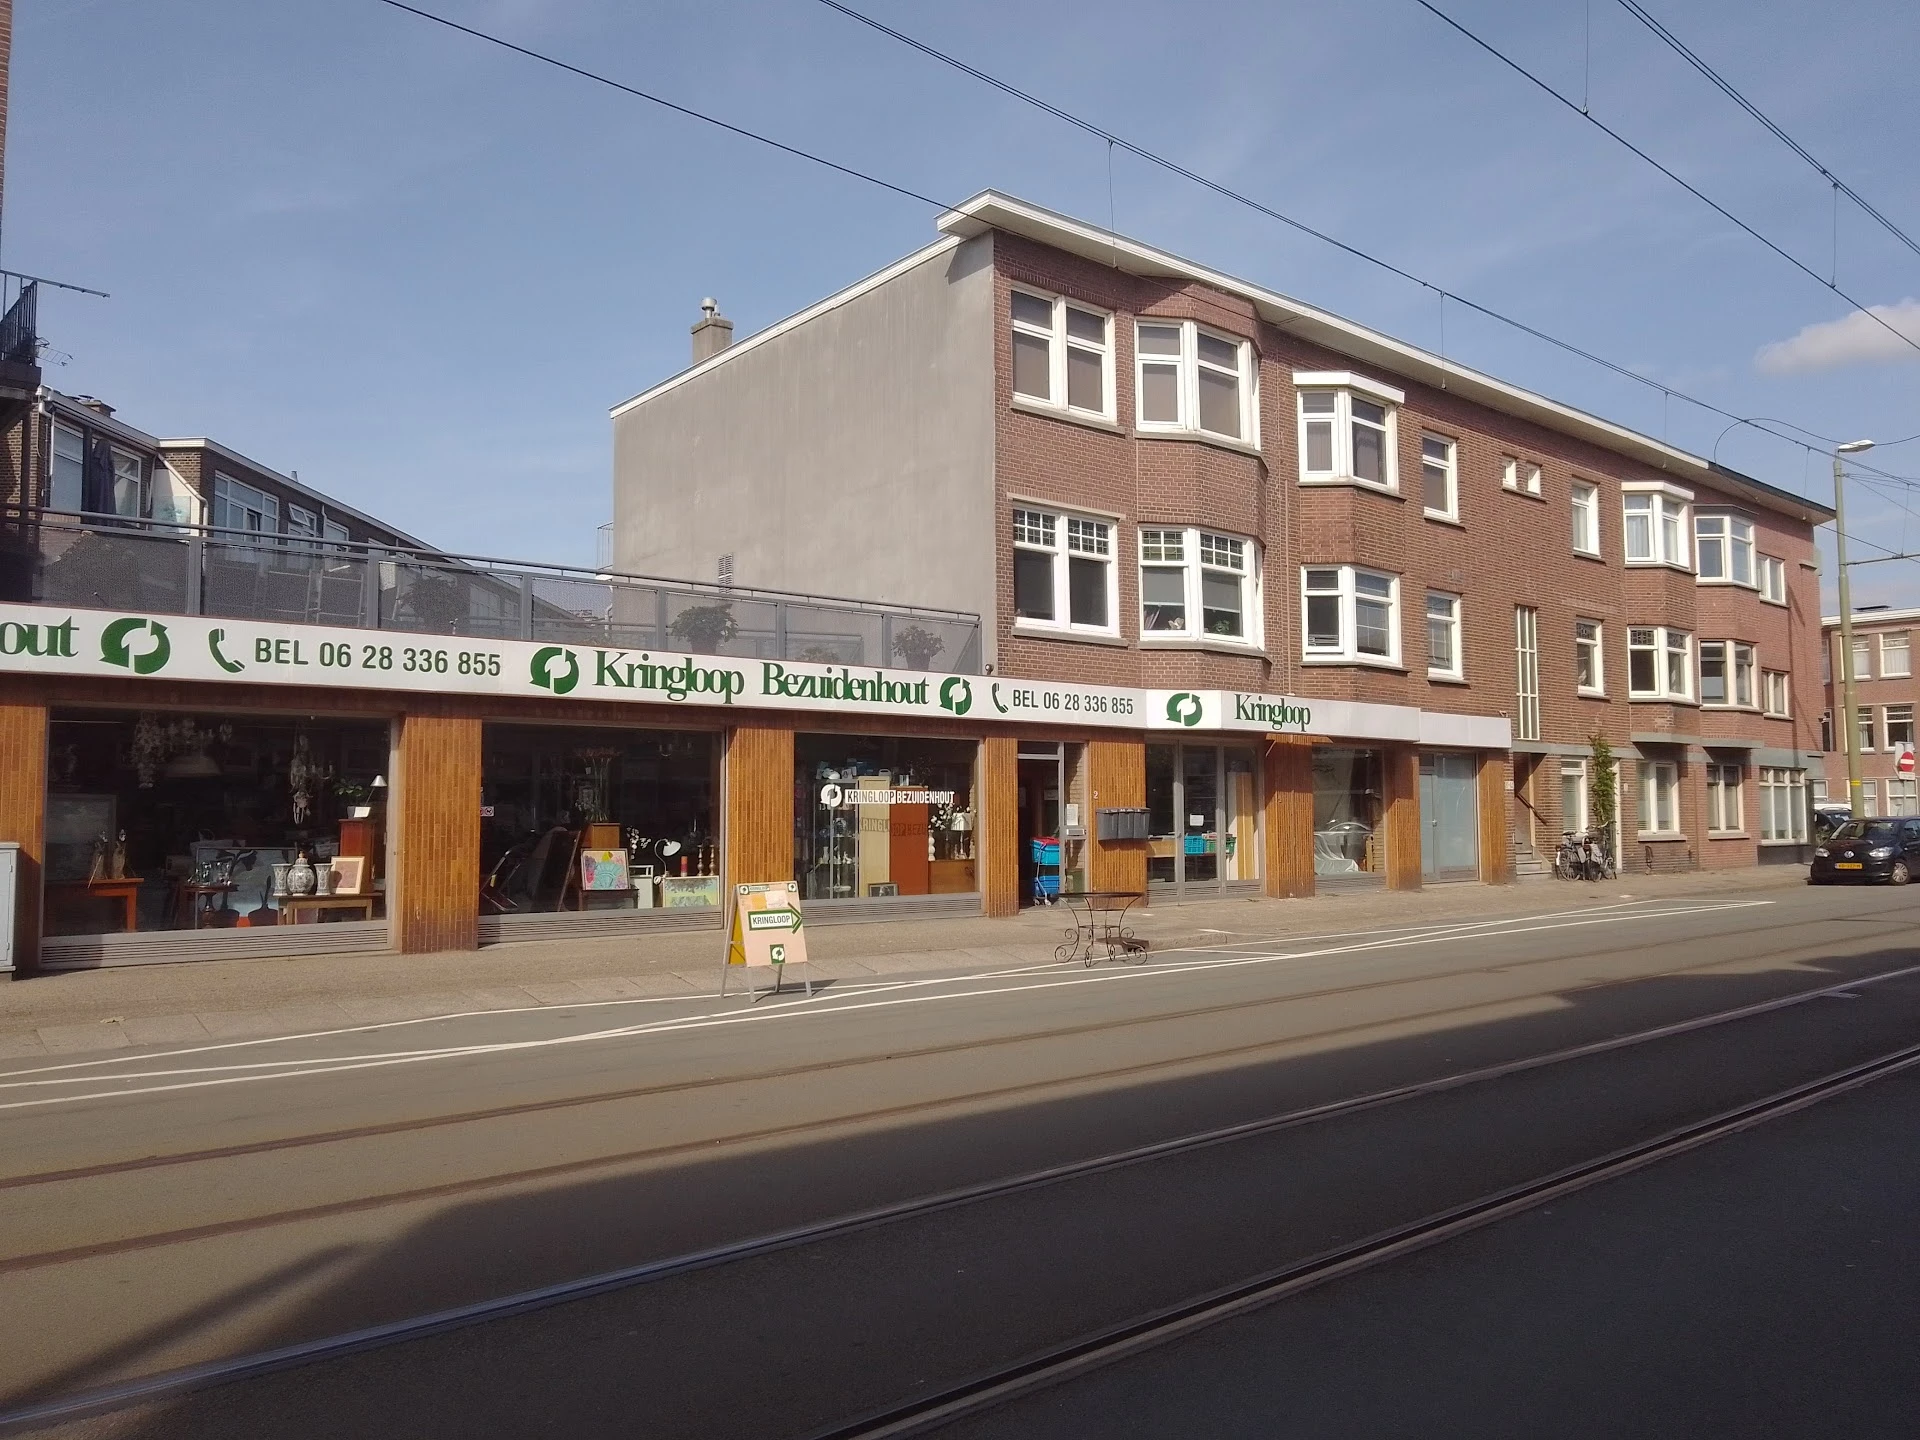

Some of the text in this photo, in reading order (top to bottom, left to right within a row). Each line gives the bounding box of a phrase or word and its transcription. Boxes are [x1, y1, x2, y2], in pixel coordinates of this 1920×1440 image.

[0, 616, 80, 658] out
[254, 637, 501, 677] BEL 06 28 336 855
[592, 650, 931, 705] Kringloop Bezuidenhout
[1013, 689, 1134, 715] BEL 06 28 336 855
[1235, 693, 1311, 733] Kringloop
[847, 790, 955, 805] KRINGLOOP BEZUIDENHOUT
[752, 915, 791, 925] KRINGLOOP
